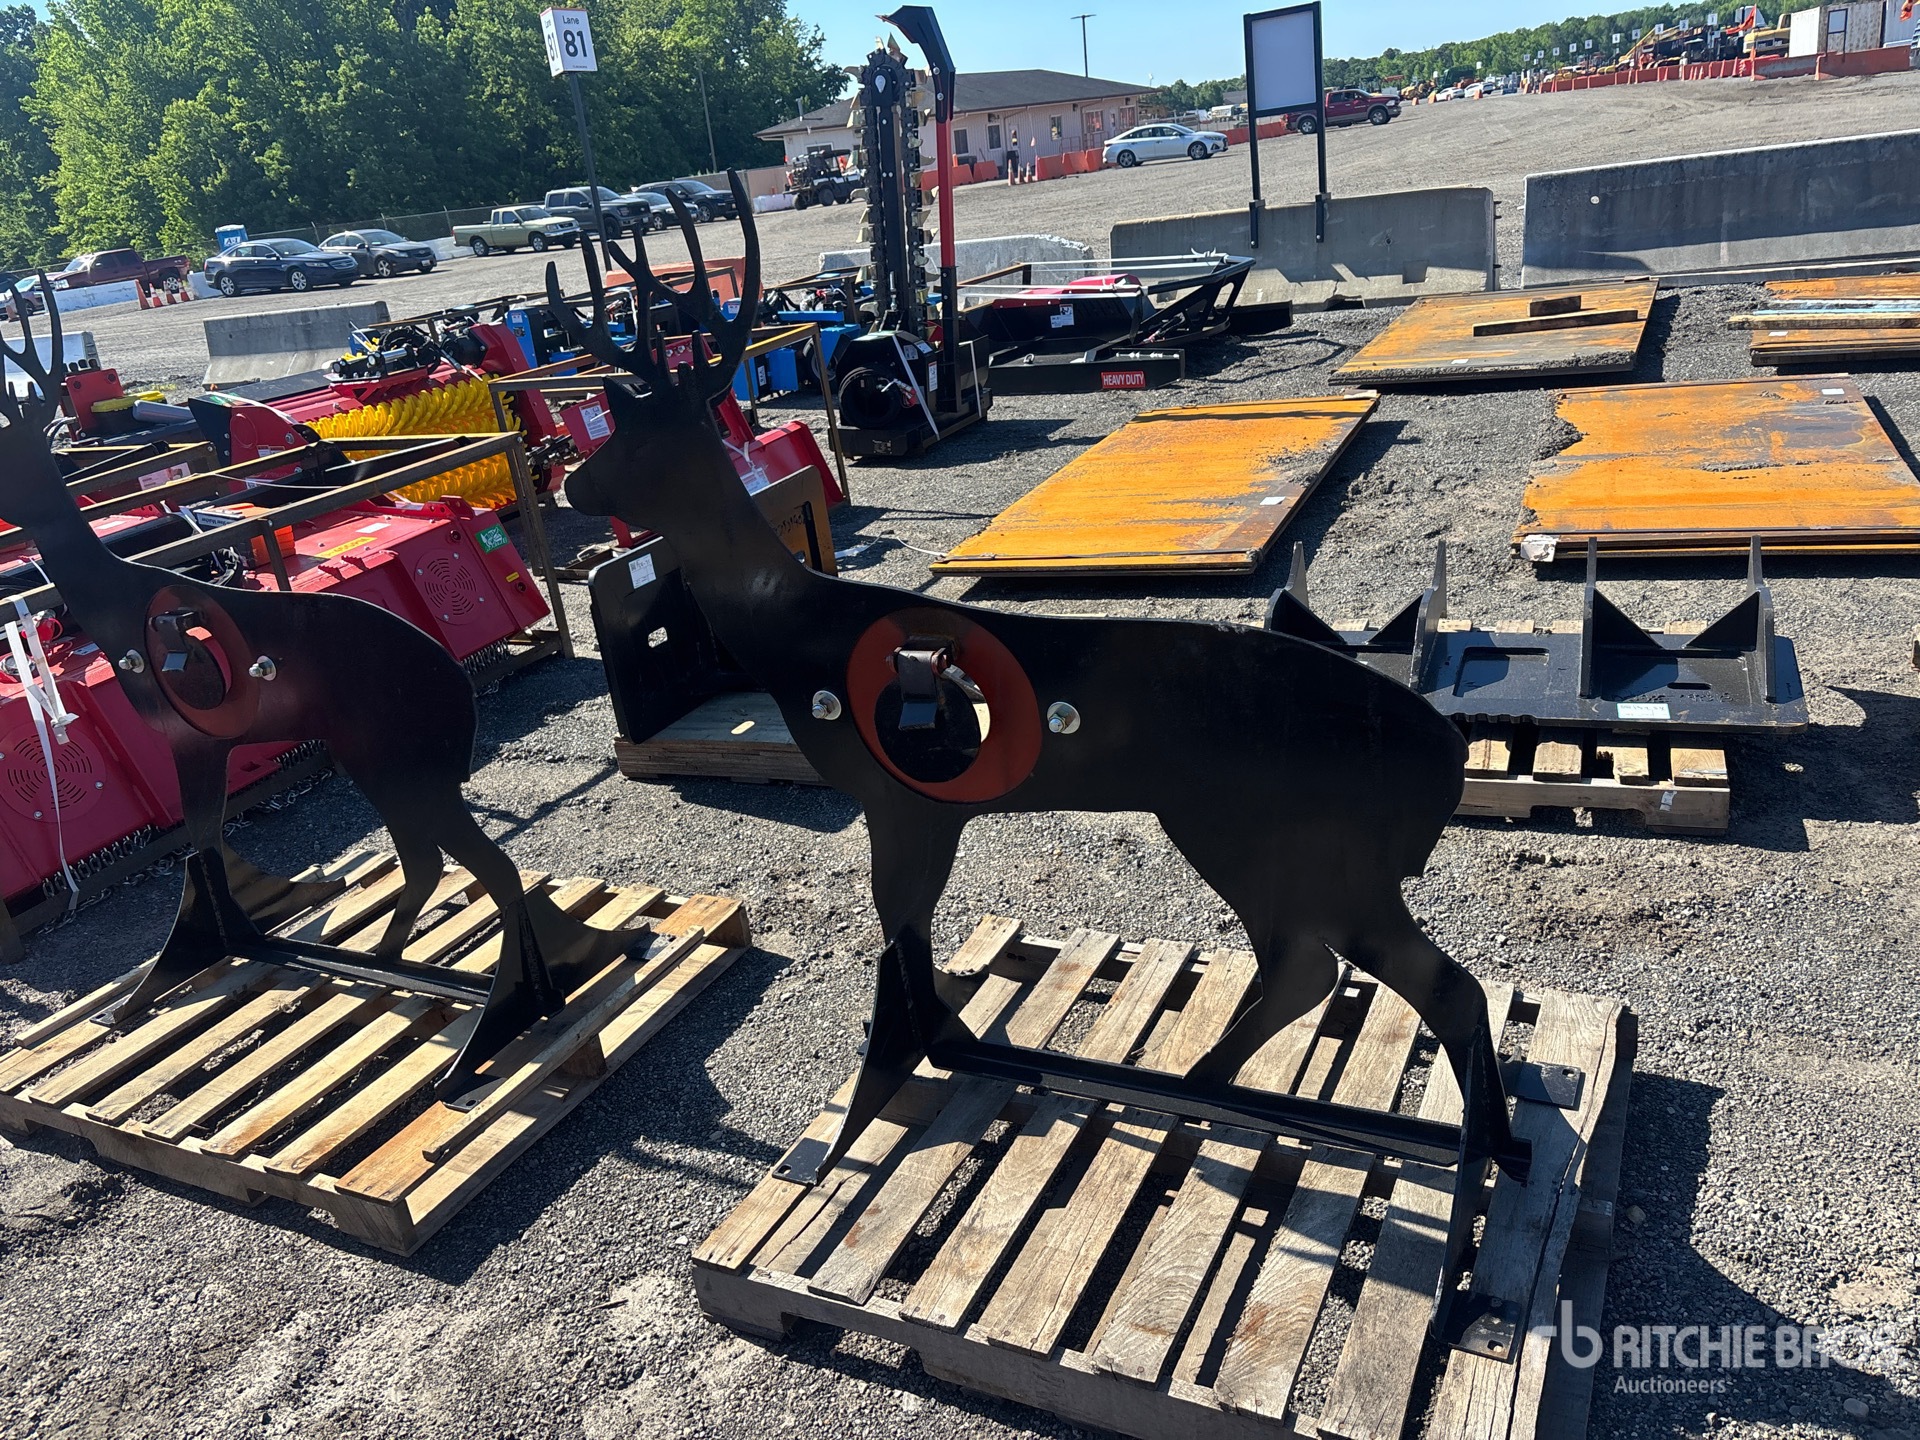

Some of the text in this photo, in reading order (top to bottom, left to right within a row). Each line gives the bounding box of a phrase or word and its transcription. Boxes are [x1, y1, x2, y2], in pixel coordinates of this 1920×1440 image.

[562, 15, 580, 25] Lane
[547, 32, 559, 62] 81
[563, 29, 588, 58] 81
[1103, 373, 1144, 386] HEAVY DUTY
